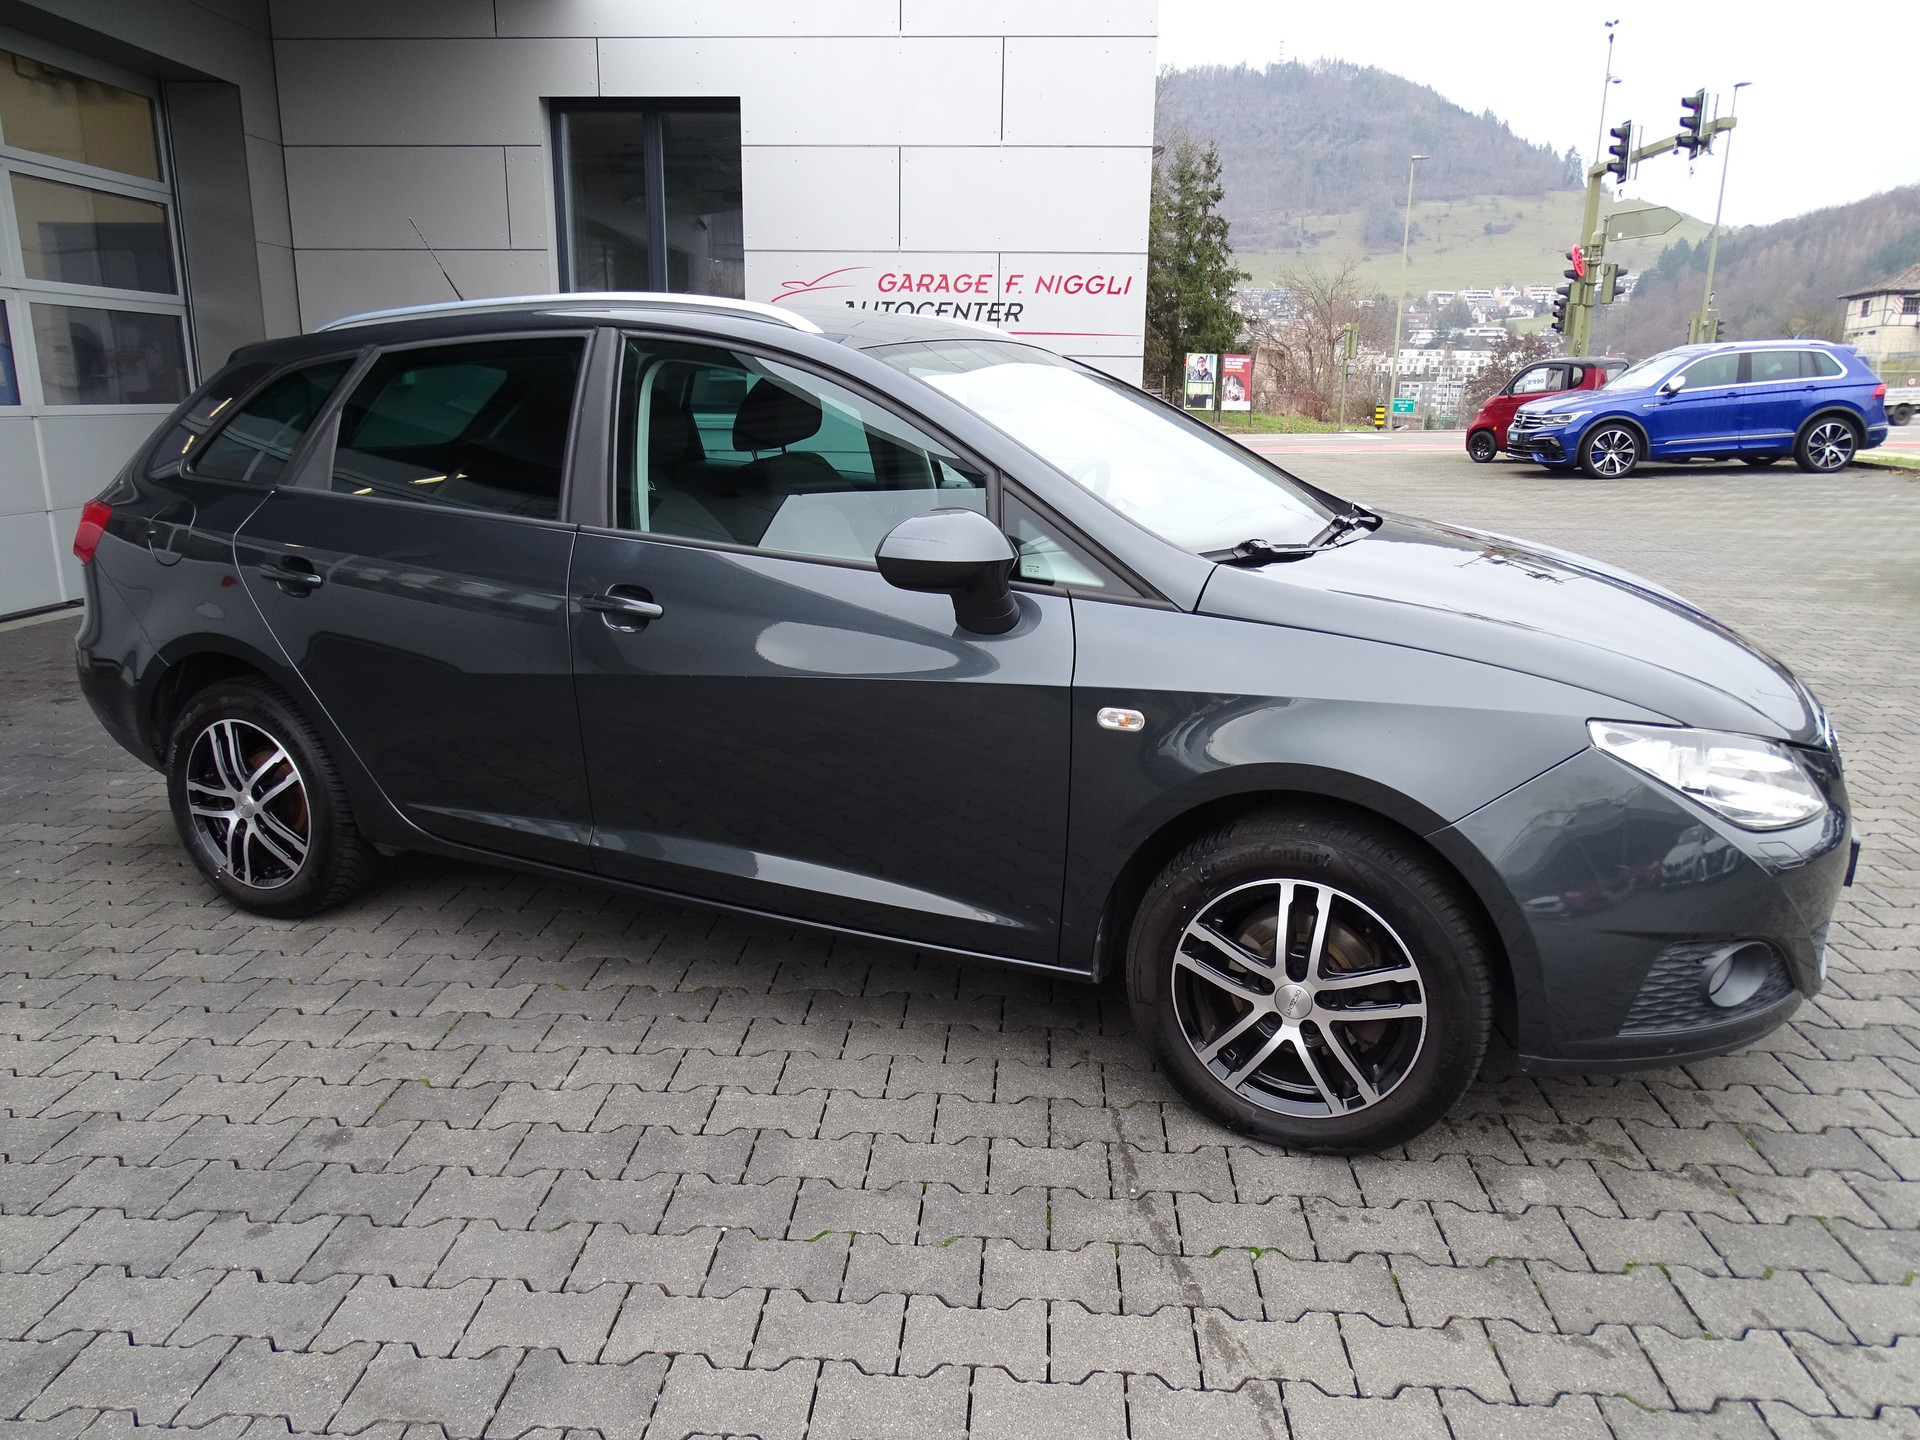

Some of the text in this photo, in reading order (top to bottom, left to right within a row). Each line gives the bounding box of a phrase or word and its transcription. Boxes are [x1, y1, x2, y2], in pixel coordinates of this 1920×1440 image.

[877, 272, 1132, 295] GARAGE F. NIGGLI
